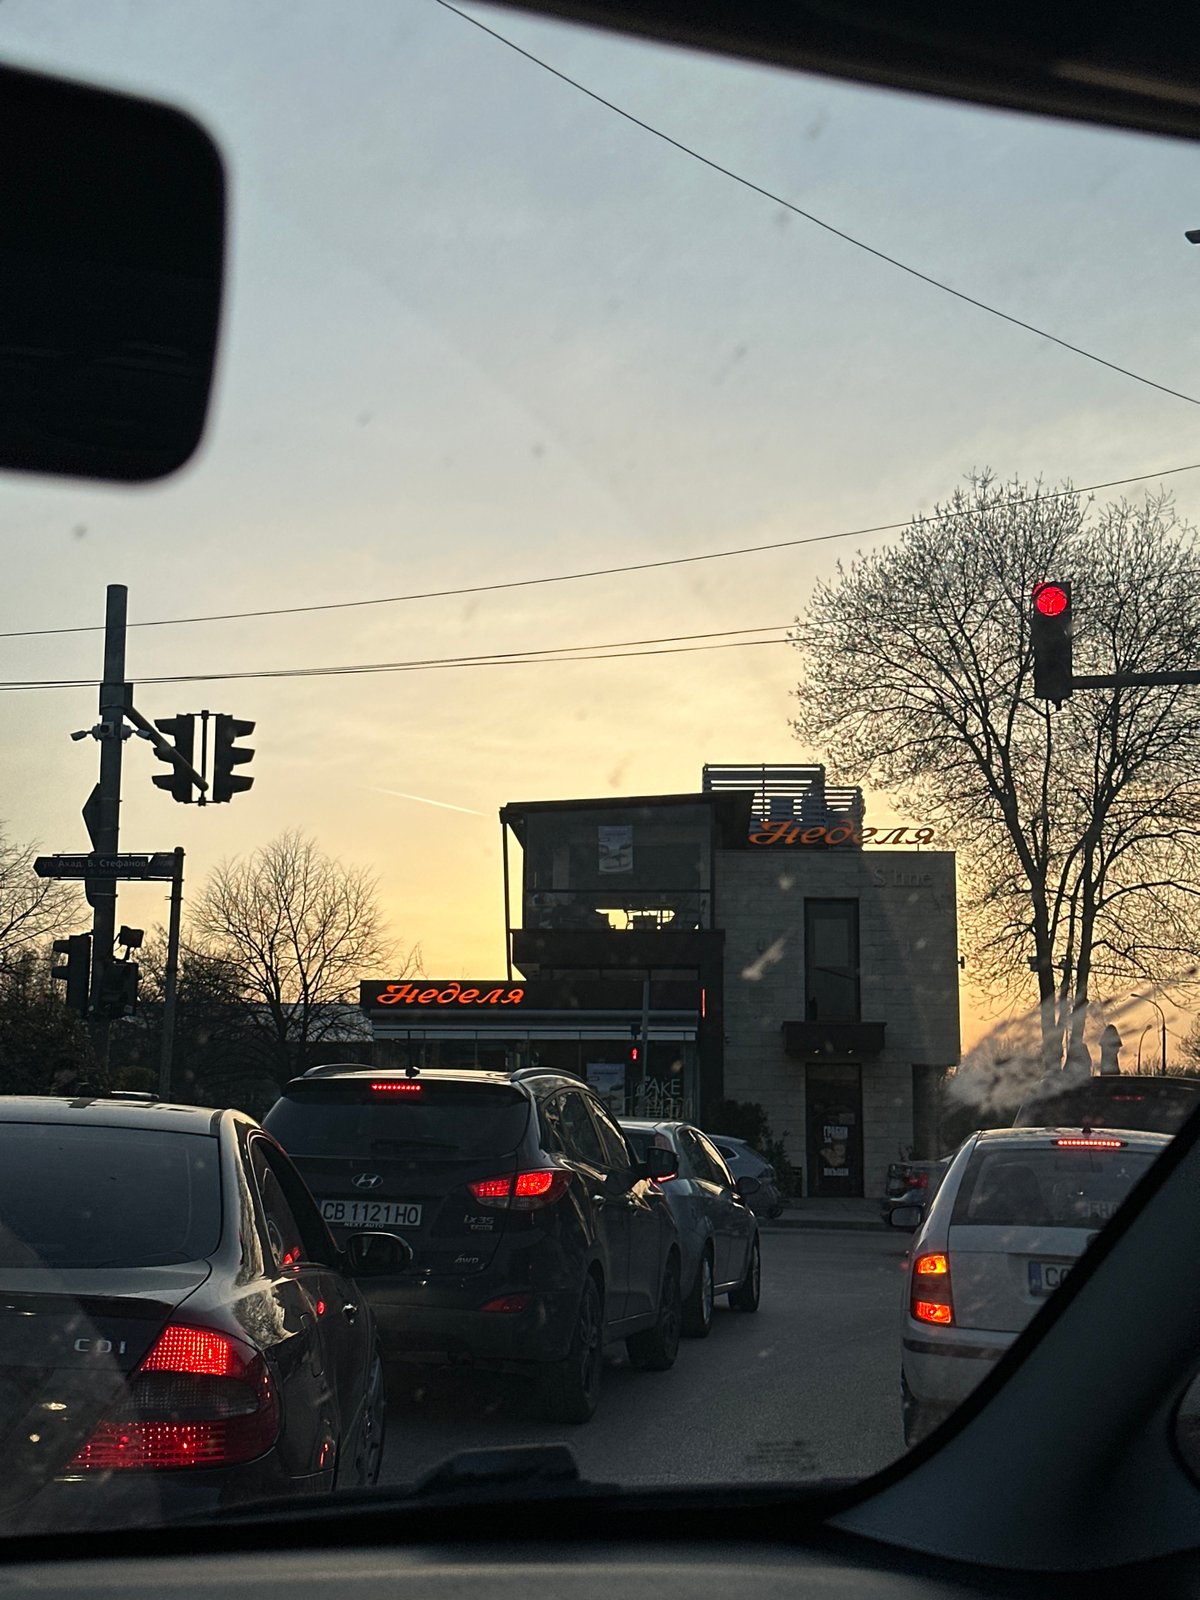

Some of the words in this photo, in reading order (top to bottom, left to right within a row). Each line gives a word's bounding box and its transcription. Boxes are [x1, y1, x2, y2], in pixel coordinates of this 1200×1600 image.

[747, 819, 935, 845] Неделя
[99, 858, 147, 872] Стефанов
[376, 981, 525, 1005] Неделя
[641, 1077, 681, 1098] AKE
[323, 1202, 345, 1220] CB
[351, 1203, 391, 1222] 1121
[395, 1206, 419, 1224] HO
[73, 1337, 127, 1355] CDI
